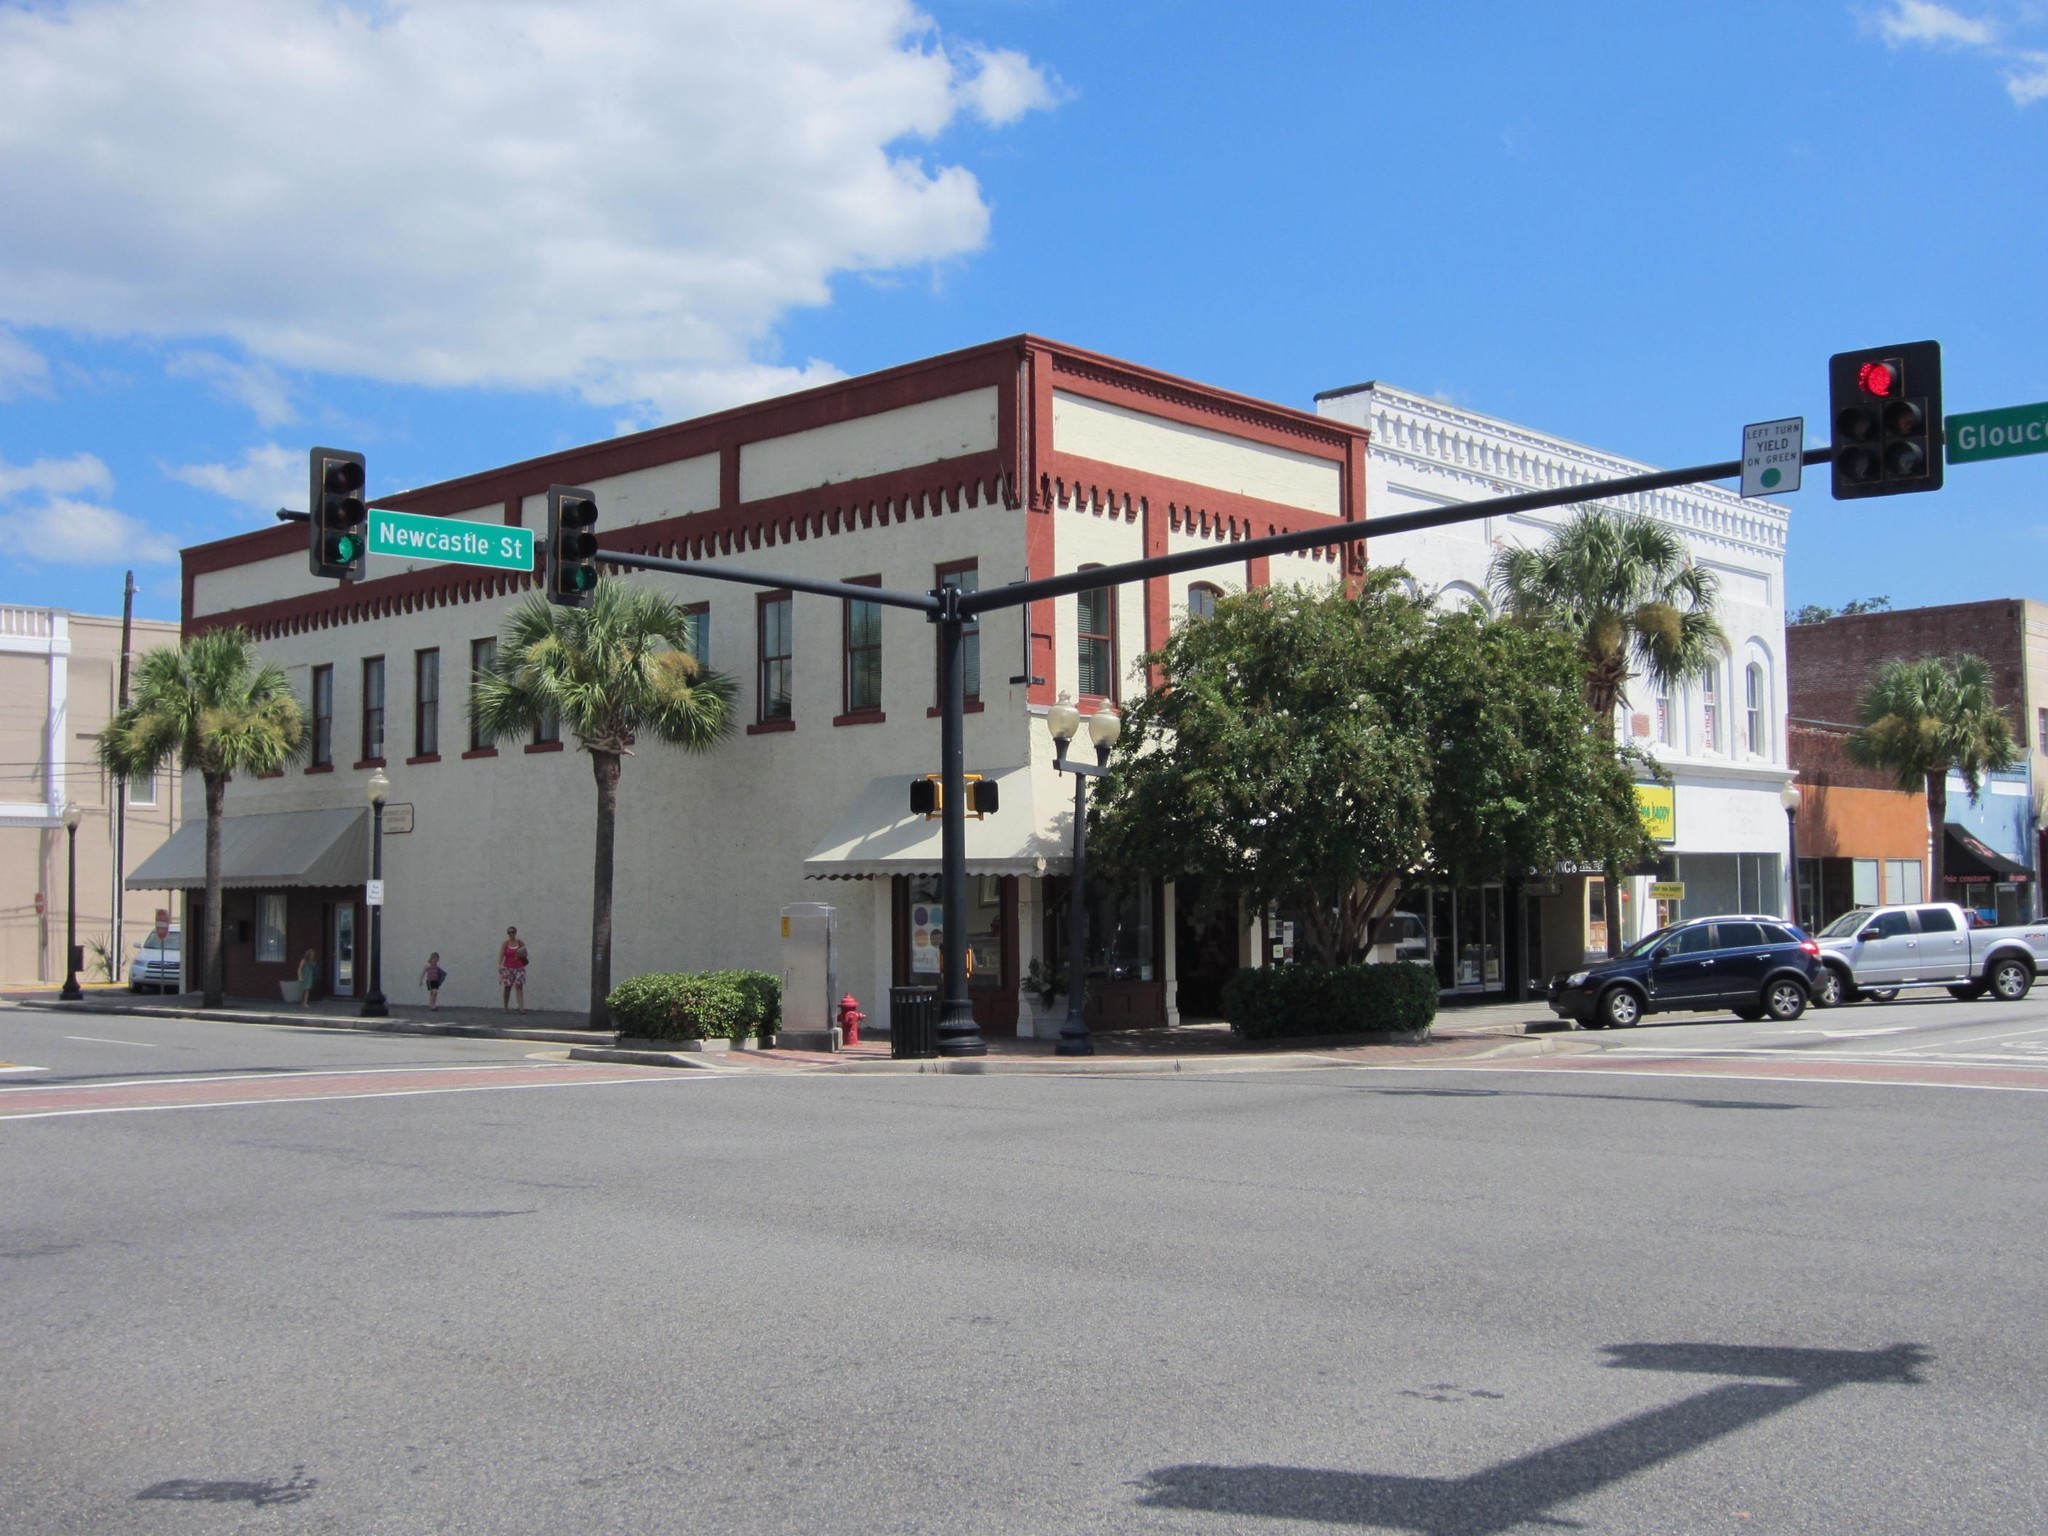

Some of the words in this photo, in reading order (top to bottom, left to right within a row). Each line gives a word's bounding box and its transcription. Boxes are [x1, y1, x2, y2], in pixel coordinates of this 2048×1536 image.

[1747, 428, 1769, 440] LEFT
[1776, 423, 1800, 435] TURN
[1958, 420, 2048, 450] Glouc
[1757, 437, 1788, 453] YIELD
[1747, 457, 1760, 467] ON
[1767, 451, 1797, 464] GREEN
[380, 521, 489, 556] Newcastle
[500, 536, 523, 560] St
